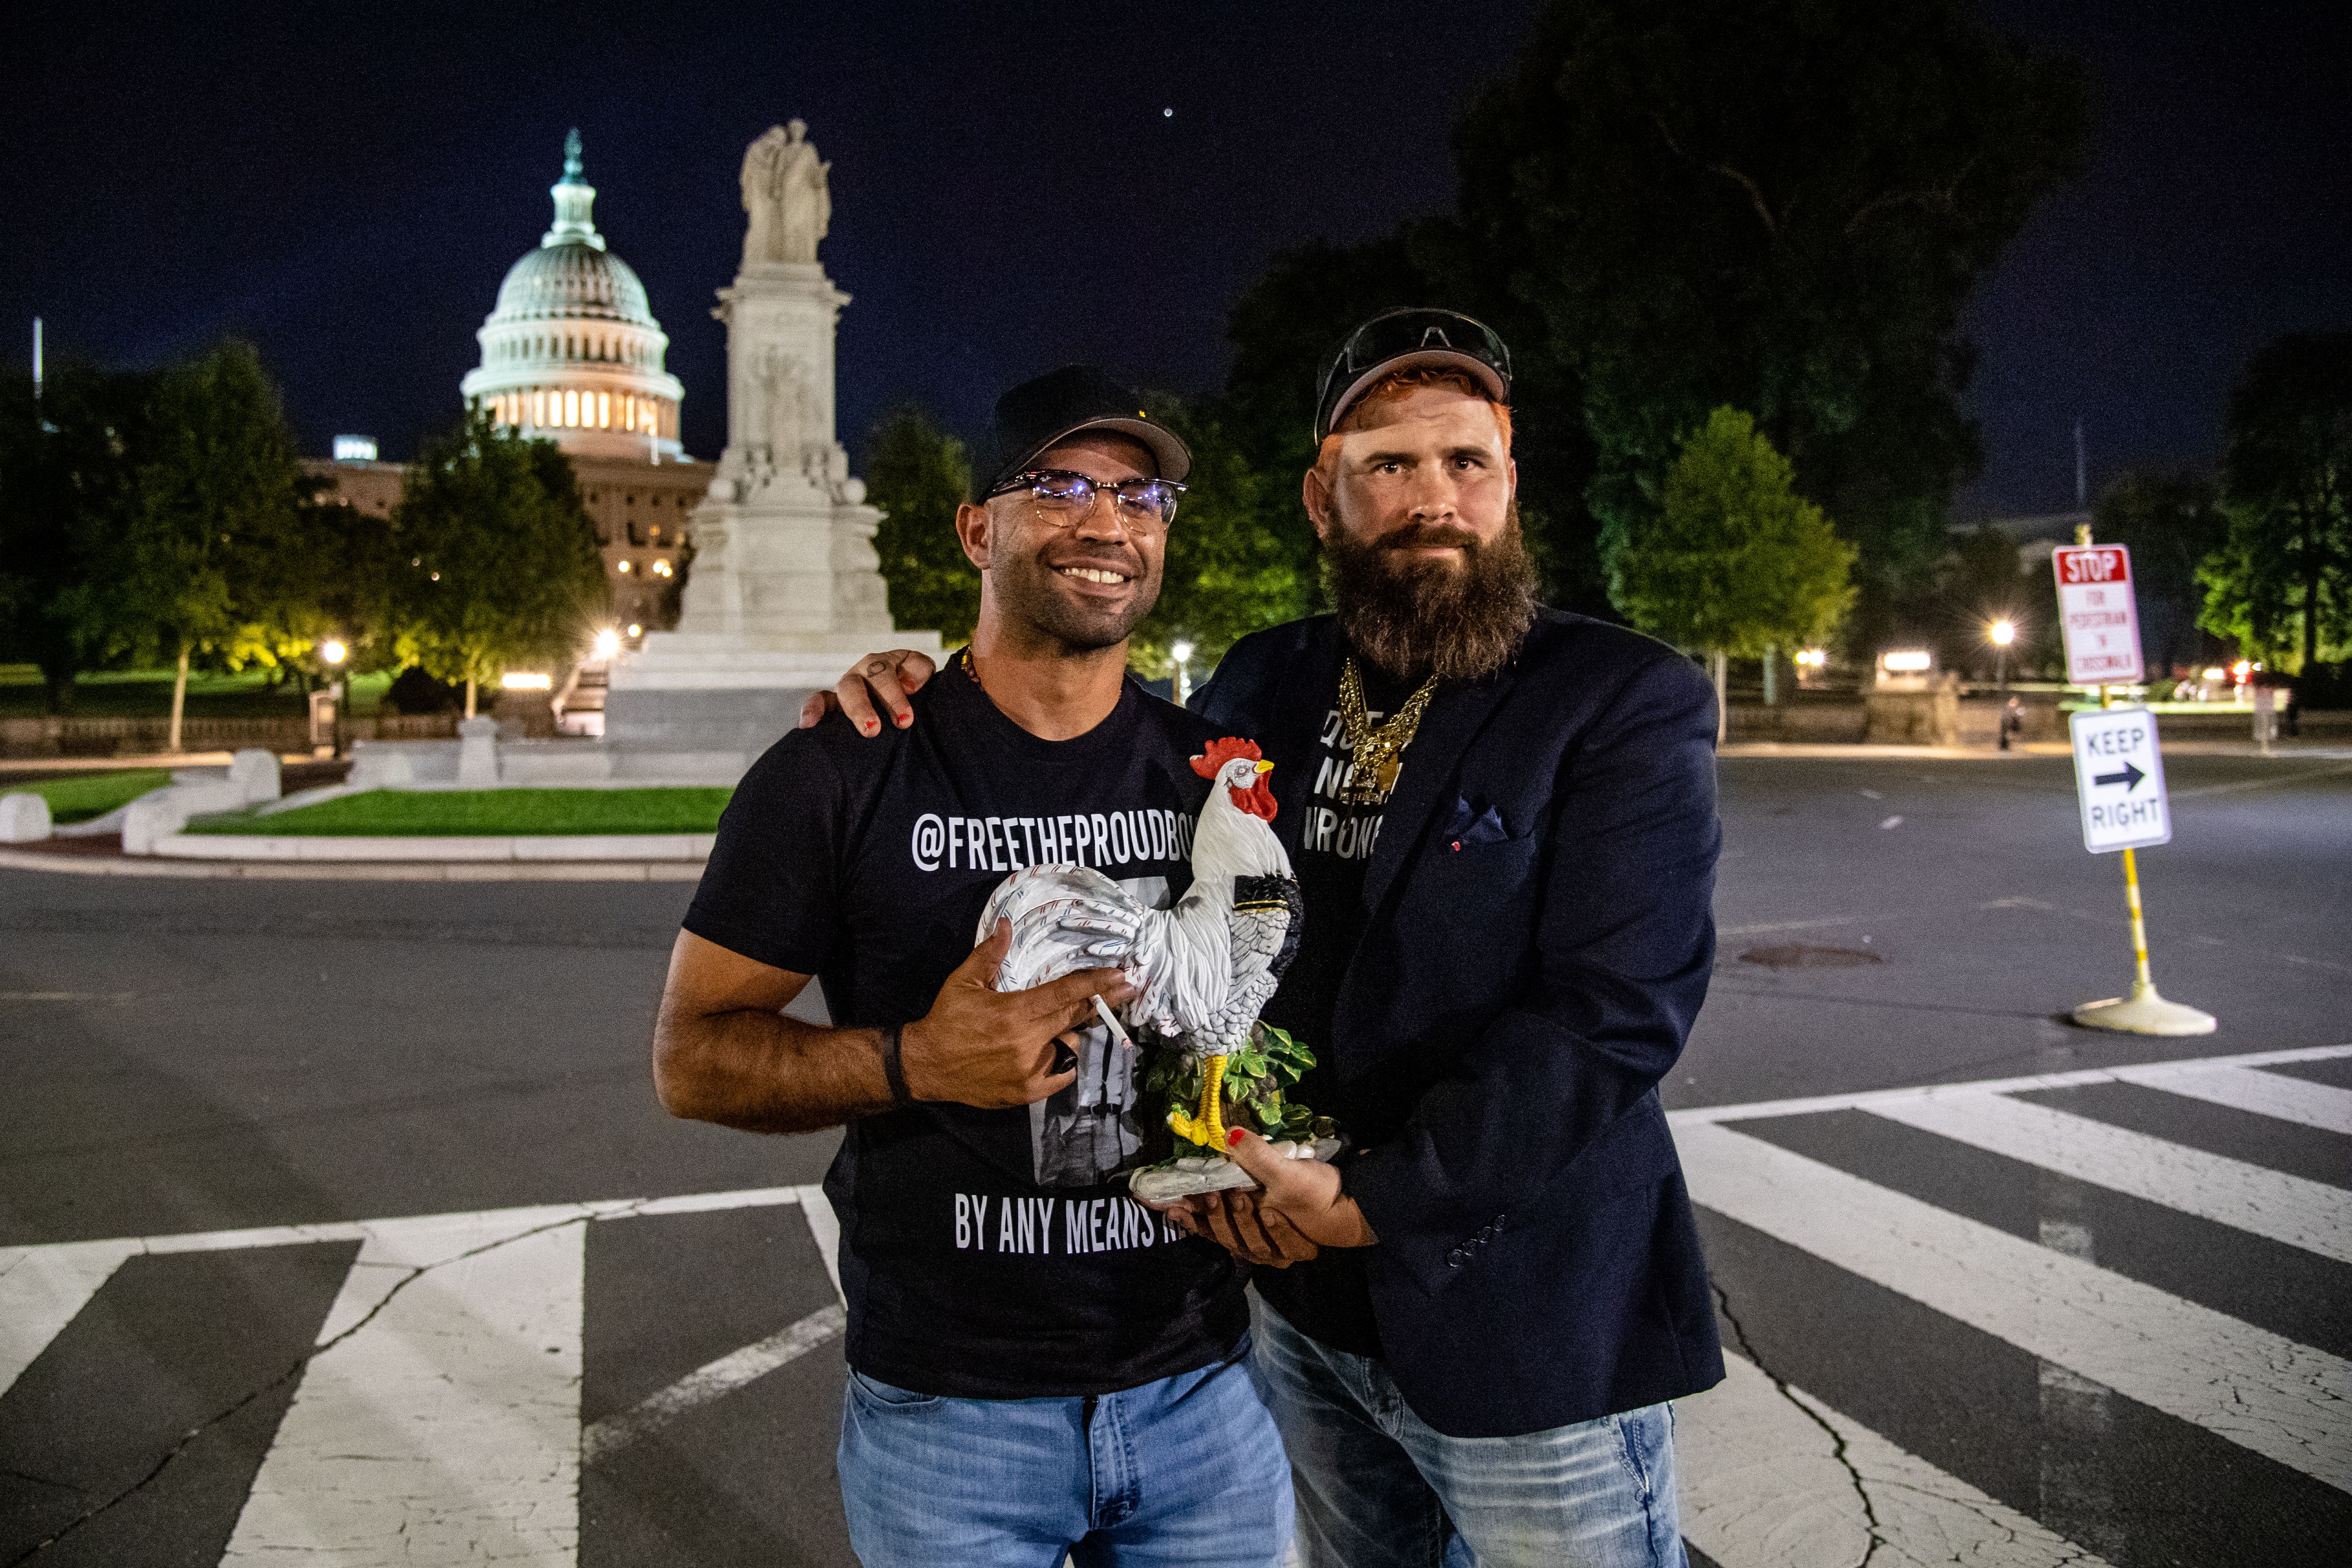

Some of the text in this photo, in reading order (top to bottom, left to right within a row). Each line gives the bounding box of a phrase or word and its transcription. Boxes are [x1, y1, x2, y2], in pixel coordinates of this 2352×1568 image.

[2065, 552, 2117, 582] STOP
[2086, 727, 2145, 758] KEEP
[2090, 798, 2157, 829] RIGHT
[955, 1193, 987, 1250] BY
[999, 1197, 1055, 1254] ANY
[1065, 1196, 1154, 1254] MEANS
